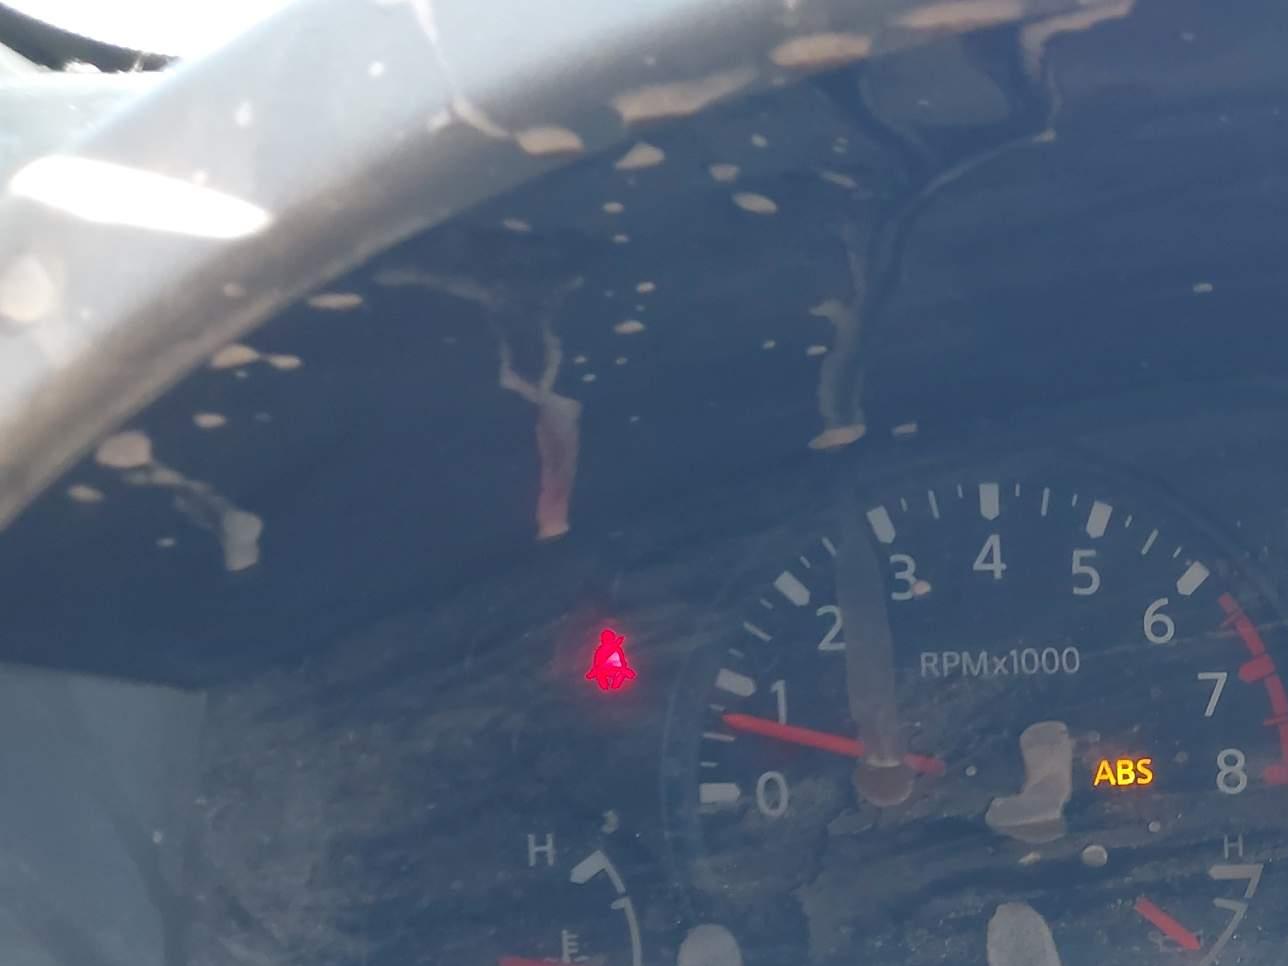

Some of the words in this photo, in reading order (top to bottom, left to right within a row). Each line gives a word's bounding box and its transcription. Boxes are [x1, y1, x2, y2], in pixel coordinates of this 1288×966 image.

[891, 554, 917, 600] 3
[973, 534, 1007, 579] 4
[1071, 550, 1100, 595] 5
[816, 605, 846, 651] 2
[1143, 598, 1174, 644] 6
[920, 647, 1081, 677] RPMx1000
[769, 680, 786, 724] 1
[1198, 672, 1228, 717] 7
[756, 771, 788, 817] 0
[1093, 757, 1153, 787] ABS
[1216, 749, 1246, 794] 8
[527, 834, 555, 867] H
[1224, 835, 1242, 859] H
